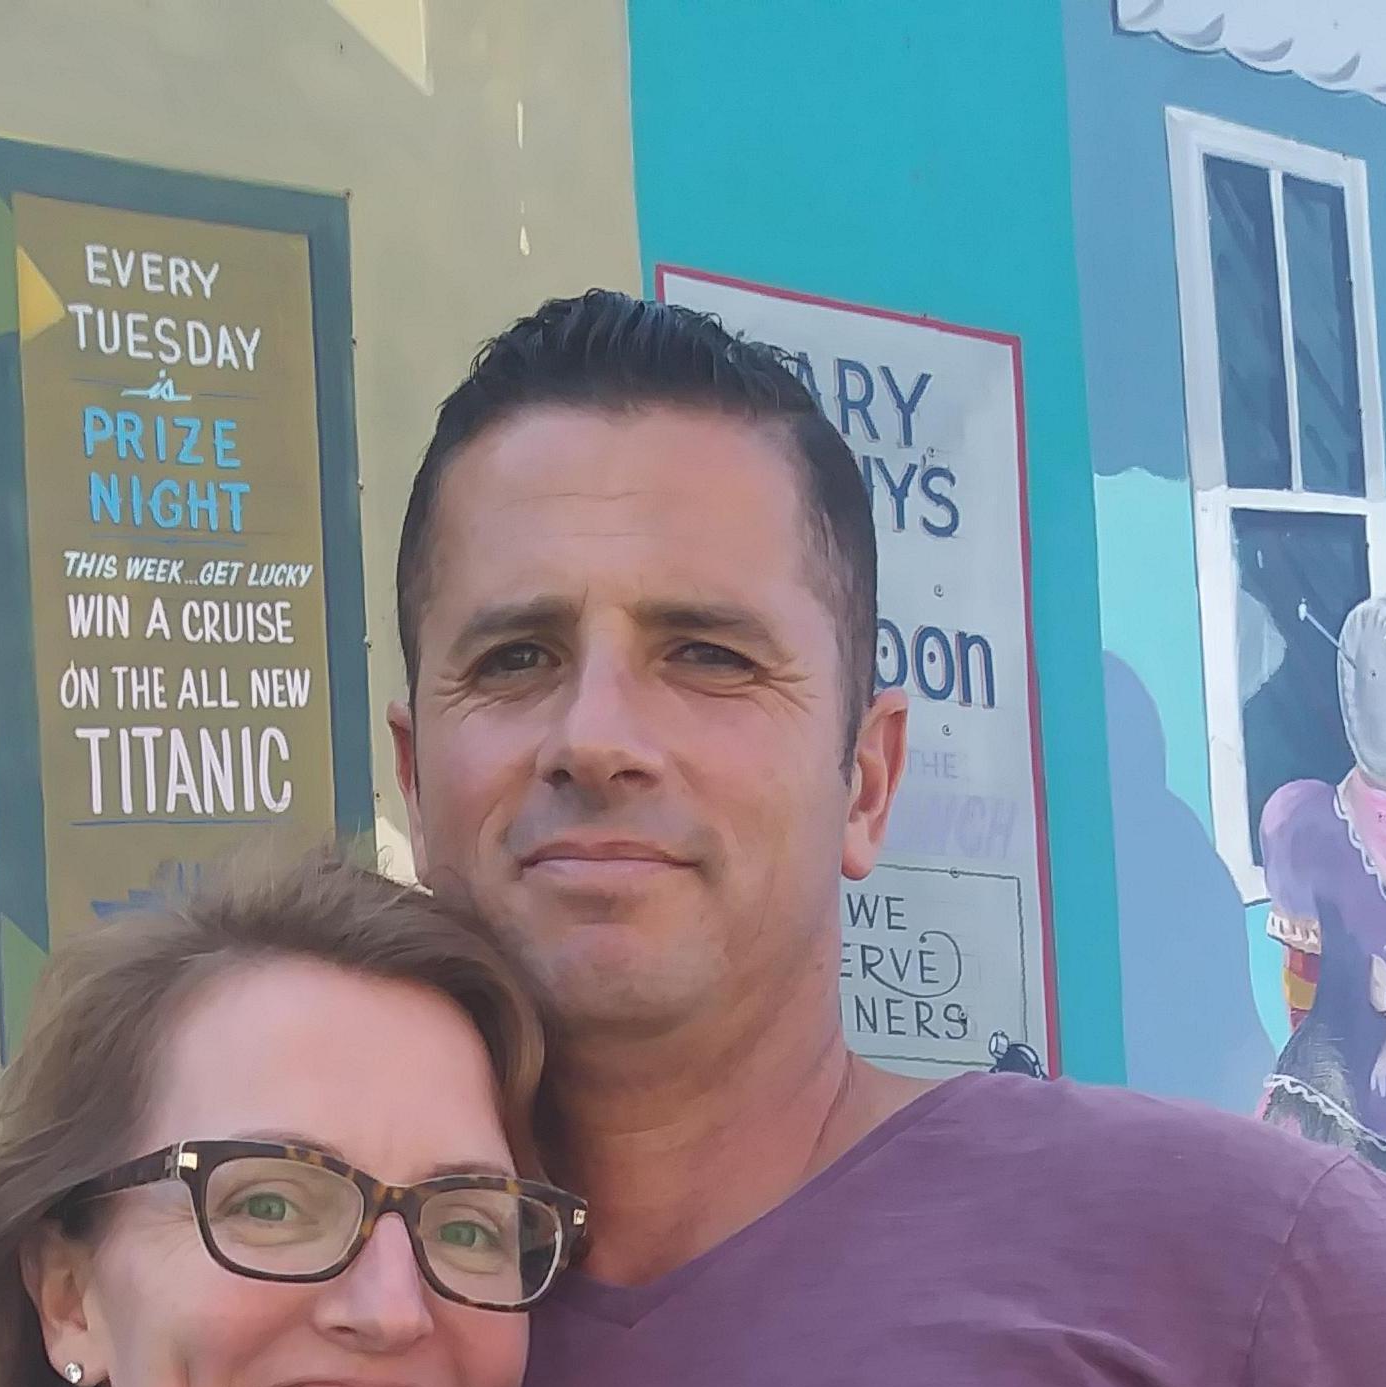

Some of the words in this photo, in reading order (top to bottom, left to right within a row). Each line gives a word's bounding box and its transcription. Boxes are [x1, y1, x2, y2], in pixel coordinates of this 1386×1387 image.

[85, 244, 220, 299] EVERY
[67, 304, 261, 371] TUESDAY
[120, 369, 192, 402] is
[84, 405, 242, 469] PRIZE
[89, 471, 251, 534] NIGHT
[63, 550, 118, 579] THIS
[247, 563, 314, 588] LUCKY
[67, 593, 130, 640] WIN
[145, 597, 171, 641] A
[182, 600, 295, 645] CRUISE
[60, 663, 99, 710] ON
[112, 667, 168, 710] THE
[177, 667, 239, 711] ALL
[251, 668, 311, 710] NEW
[75, 726, 292, 815] TITANIC
[846, 892, 907, 930] WE
[854, 994, 967, 1039] NERS
